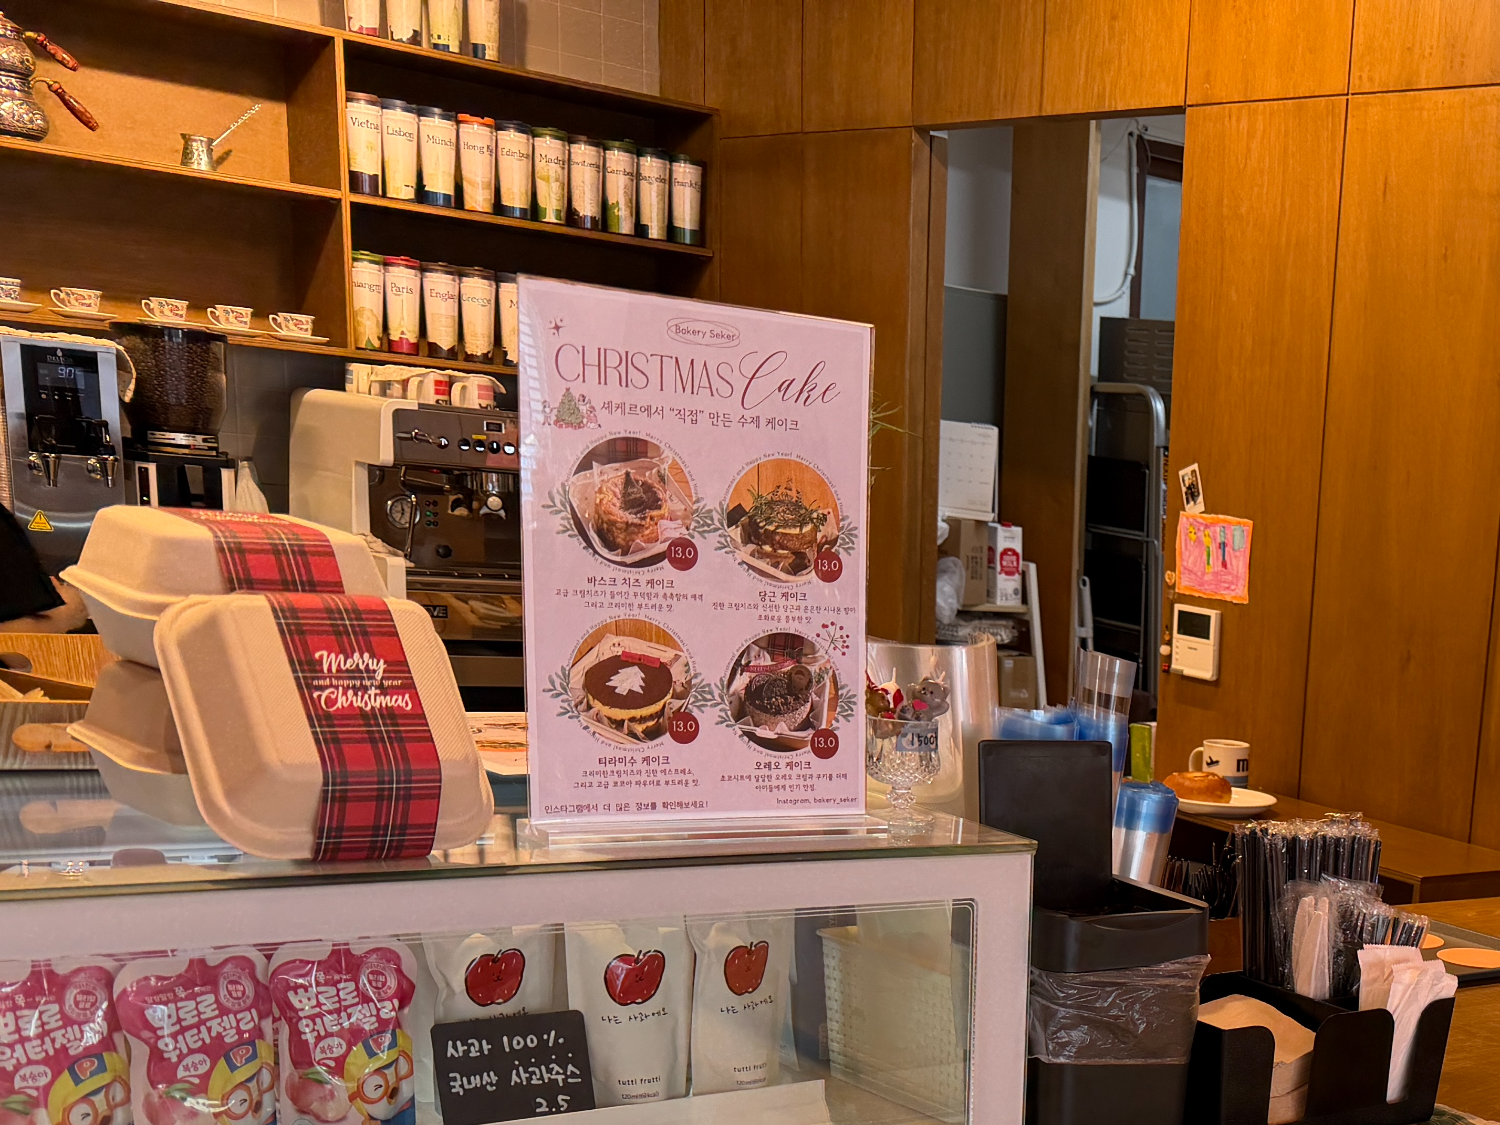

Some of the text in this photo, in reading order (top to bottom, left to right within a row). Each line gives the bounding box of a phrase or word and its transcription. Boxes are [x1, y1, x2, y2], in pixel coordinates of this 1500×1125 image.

[386, 125, 414, 140] Lisbon
[463, 141, 485, 155] Hong
[390, 282, 414, 295] Paris
[461, 293, 492, 305] Greece
[674, 324, 737, 342] Bakery Seker
[555, 343, 841, 411] CHRISTMAS Cake
[708, 411, 733, 428] 만든
[737, 414, 761, 430] 수제
[765, 416, 800, 432] 케이크
[670, 546, 694, 559] 13.0
[817, 559, 839, 572] 13.0
[587, 576, 675, 589] 바스크 치즈 케이크
[758, 590, 808, 603] 당근 케이크
[314, 650, 388, 680] Merry
[313, 677, 330, 686] and
[332, 677, 360, 687] happy
[382, 680, 402, 688] year
[313, 686, 413, 712] Christmas
[672, 720, 696, 733] 13.0
[814, 737, 836, 748] 13.0
[597, 755, 671, 768] 티라미수 케이크
[754, 760, 812, 771] 오레오 케이크
[573, 780, 594, 790] 그리고
[602, 803, 611, 812] 더
[635, 801, 657, 812] 정보를
[661, 800, 709, 811] 확인해보세요!
[287, 981, 360, 1017] 뽀로로
[144, 993, 219, 1036] 뽀로로
[720, 1007, 739, 1015] 나는
[297, 998, 399, 1044] 워터젤리
[601, 1015, 623, 1025] 나는
[157, 1008, 259, 1063] 워터젤리
[369, 1033, 392, 1053] P
[319, 1041, 344, 1056] 복숭아
[446, 1029, 565, 1058] 사과 100%
[230, 1045, 253, 1067] P
[181, 1057, 208, 1074] 복숭아
[18, 1069, 48, 1084] 복숭아
[448, 1063, 582, 1096] 국내산 사과주스
[617, 1075, 661, 1086] tutti frutti
[535, 1094, 571, 1113] 2.5
